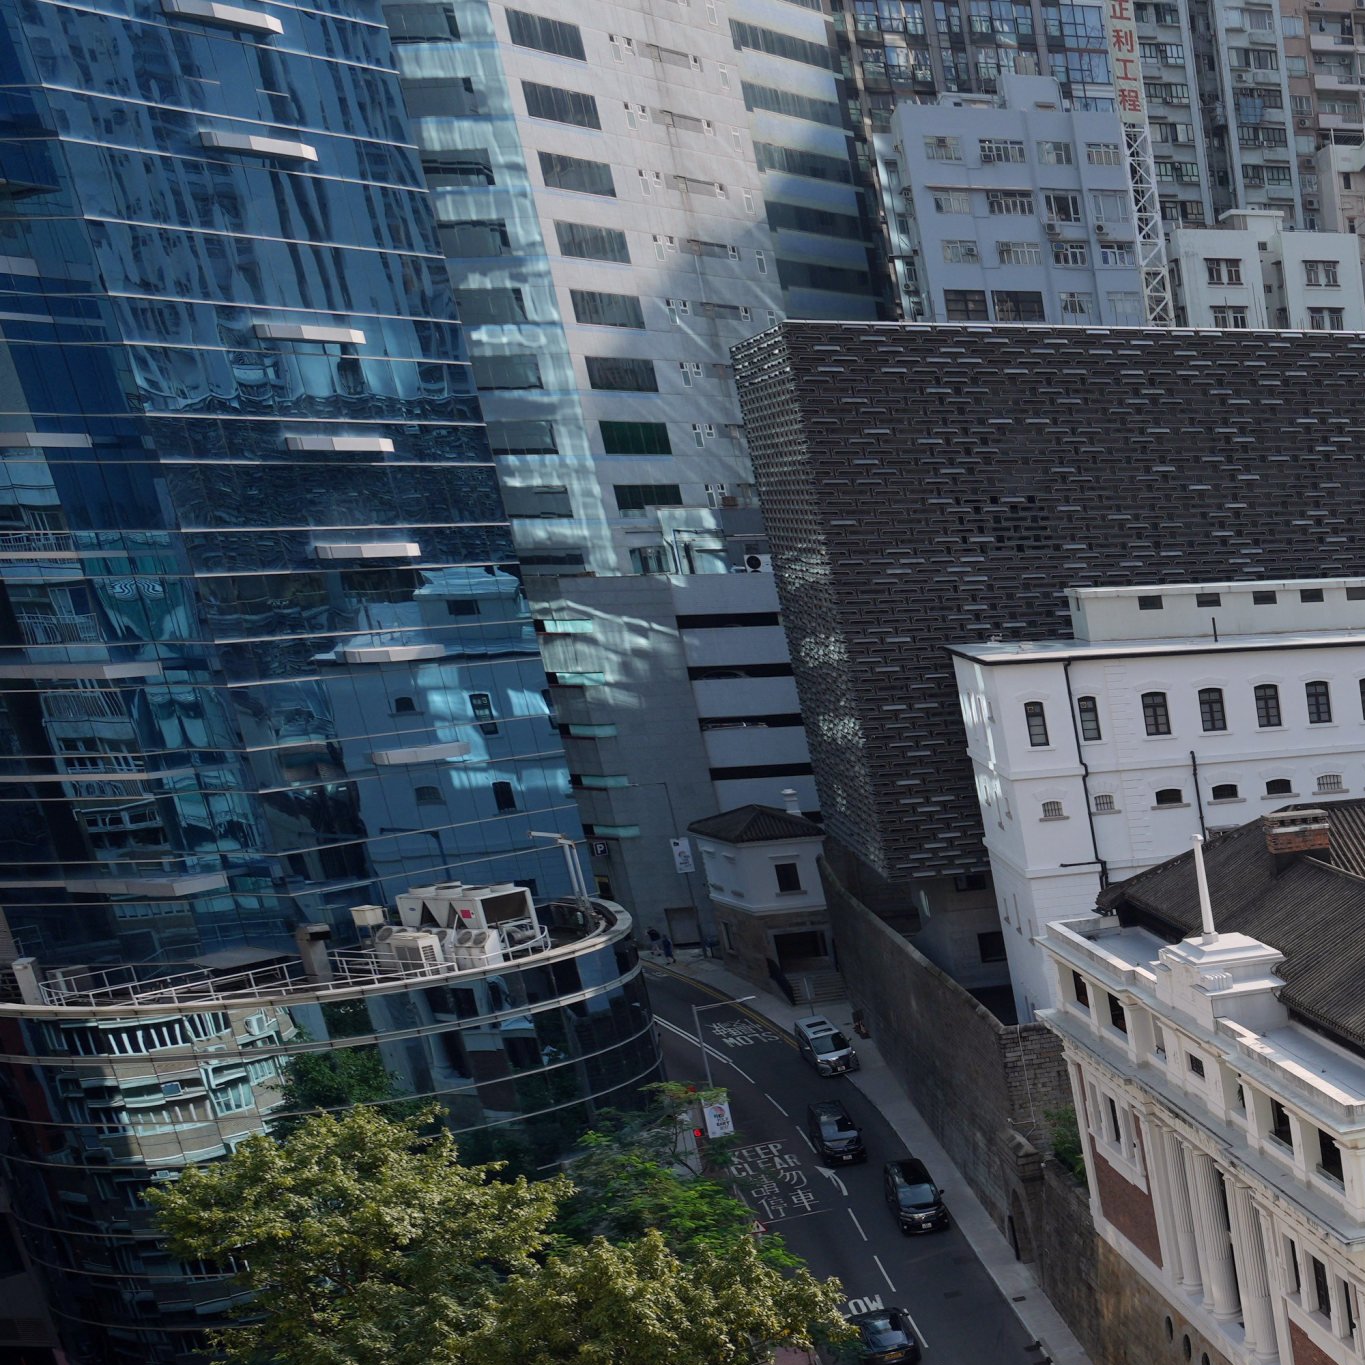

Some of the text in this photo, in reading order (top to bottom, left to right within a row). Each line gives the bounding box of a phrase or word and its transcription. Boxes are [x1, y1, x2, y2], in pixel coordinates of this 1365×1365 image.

[1110, 0, 1141, 113] 正利工程
[596, 843, 605, 855] P
[722, 1031, 780, 1048] SLOW
[729, 1142, 783, 1165] KEEP
[730, 1153, 801, 1178] CLEAR
[757, 1188, 820, 1220] 停車
